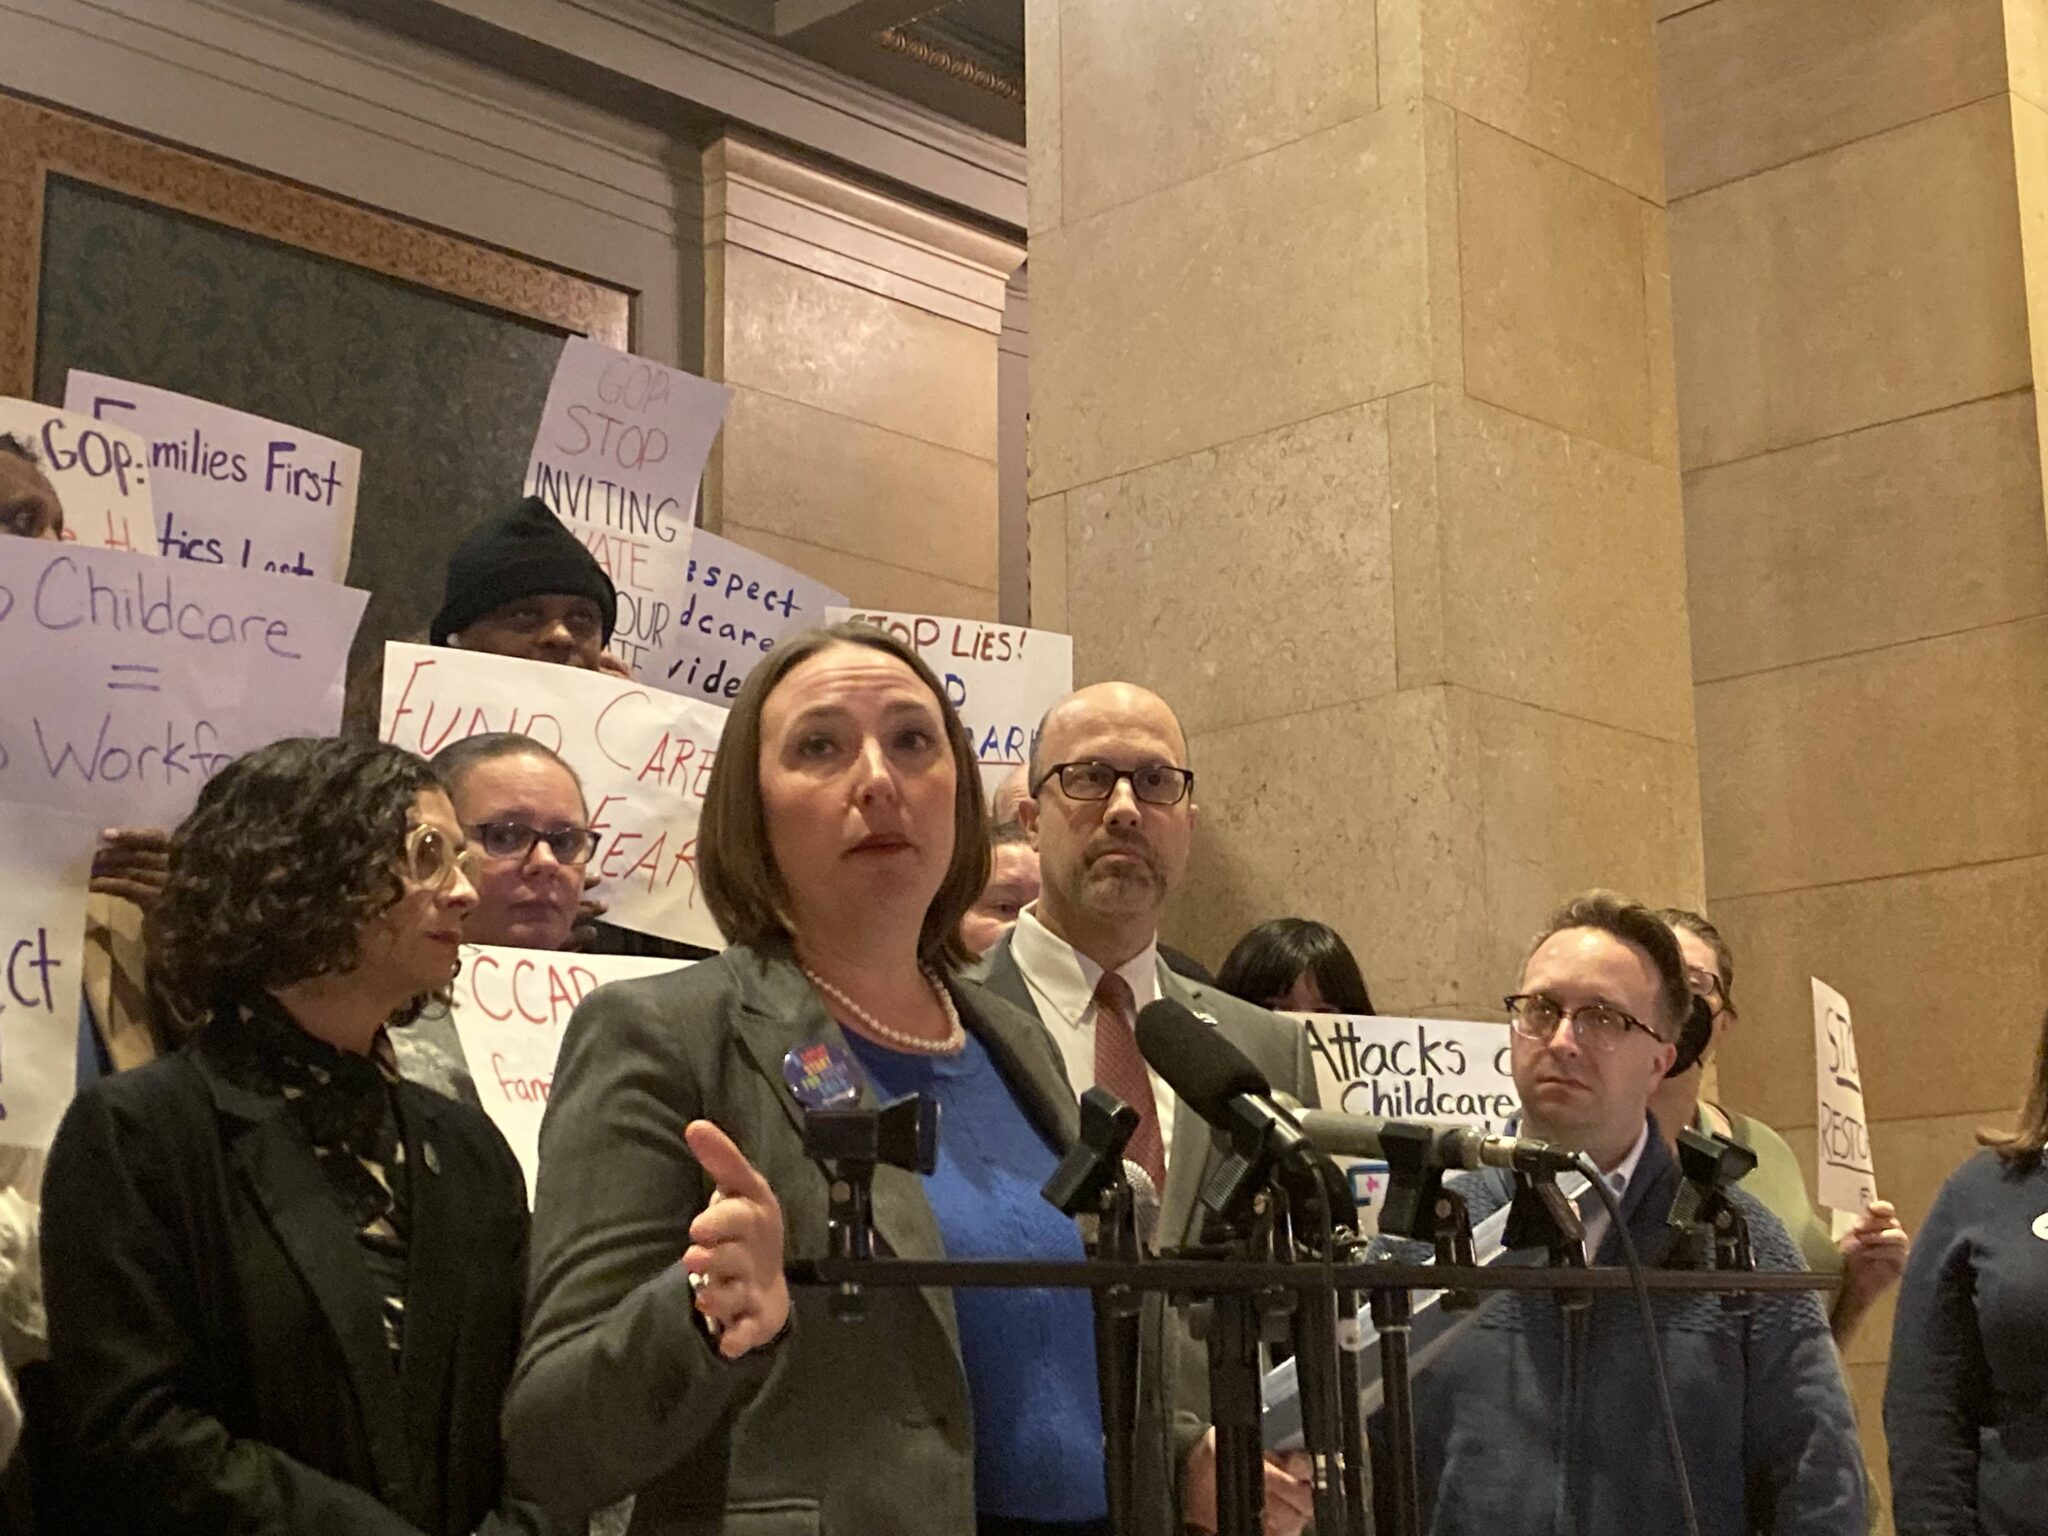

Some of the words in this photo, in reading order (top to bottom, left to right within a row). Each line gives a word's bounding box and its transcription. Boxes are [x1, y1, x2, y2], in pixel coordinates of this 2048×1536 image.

[555, 405, 668, 471] STOP
[265, 441, 344, 506] First
[534, 461, 679, 542] INVITING
[34, 556, 302, 659] Childcare
[848, 614, 940, 653] TOP
[1304, 1019, 1467, 1083] Attacks
[1341, 1077, 1519, 1119] Childcare
